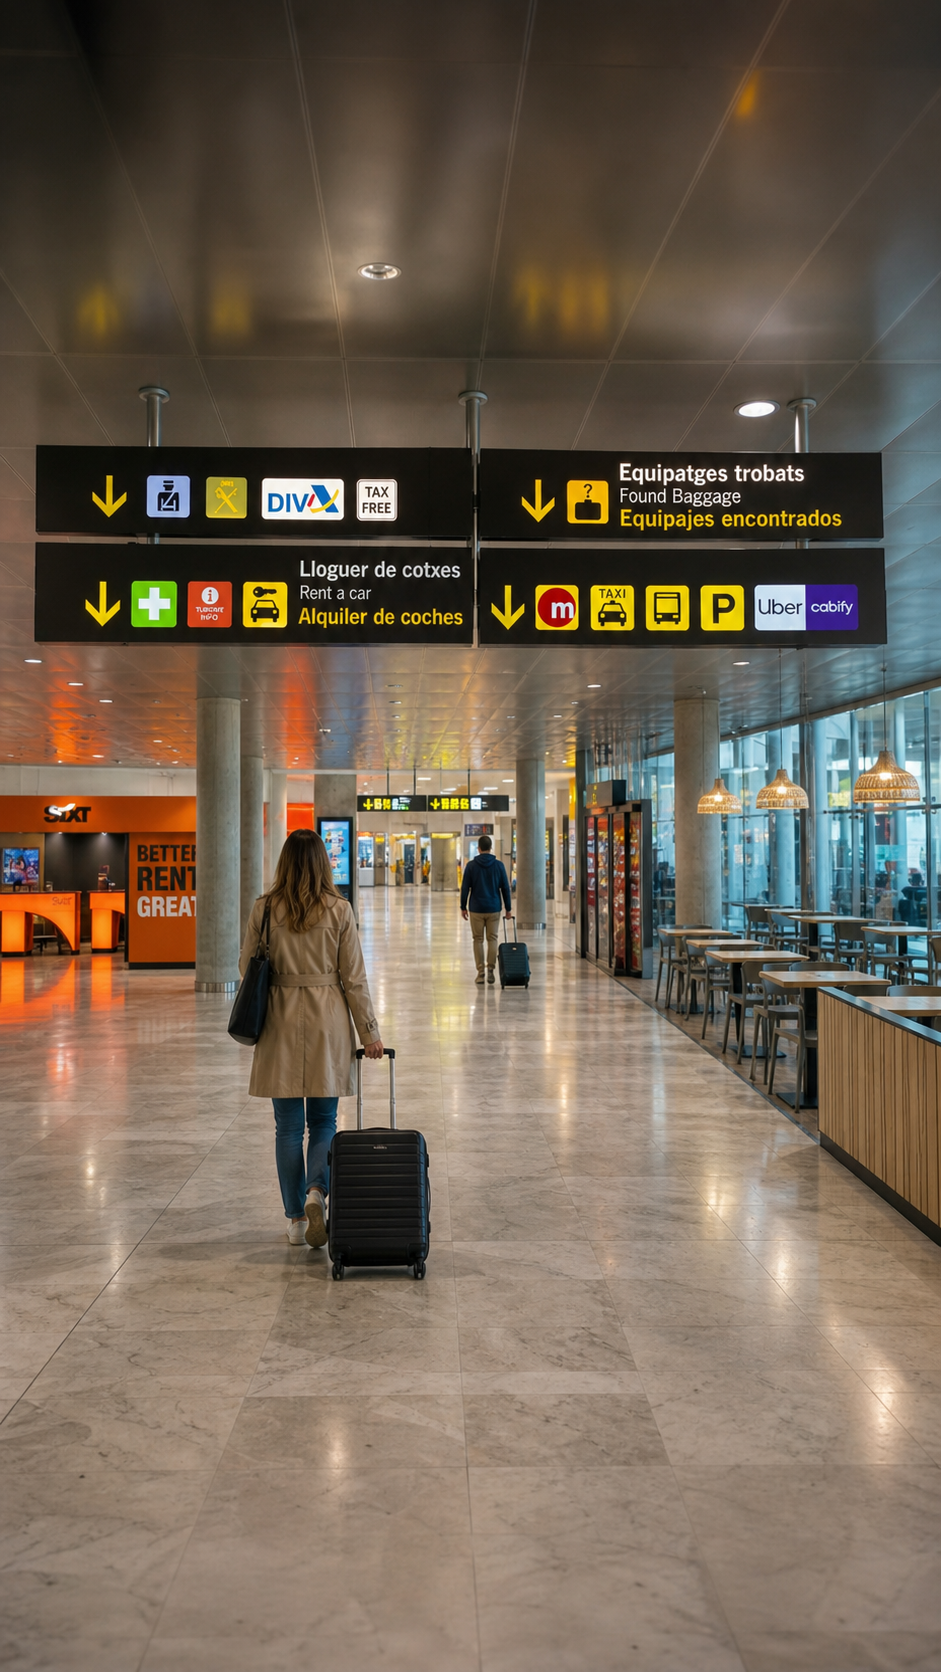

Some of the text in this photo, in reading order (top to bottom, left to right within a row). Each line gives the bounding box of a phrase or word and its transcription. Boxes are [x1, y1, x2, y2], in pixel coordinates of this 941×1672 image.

[619, 463, 805, 486] Equipatges trobats
[365, 486, 389, 498] TAX
[619, 487, 741, 507] Found Baggage
[362, 502, 391, 514] FREE
[620, 509, 842, 531] Equipajes encontrados
[300, 560, 461, 581] Lloguer de cotxes
[300, 584, 372, 600] Rent a car
[599, 588, 626, 599] TAXI
[551, 601, 574, 619] m
[712, 593, 736, 624] P
[758, 598, 803, 615] Uber
[810, 600, 853, 616] cabify
[298, 607, 463, 629] Alquiler de coches
[43, 804, 91, 823] SIXT
[137, 866, 197, 891] RENT
